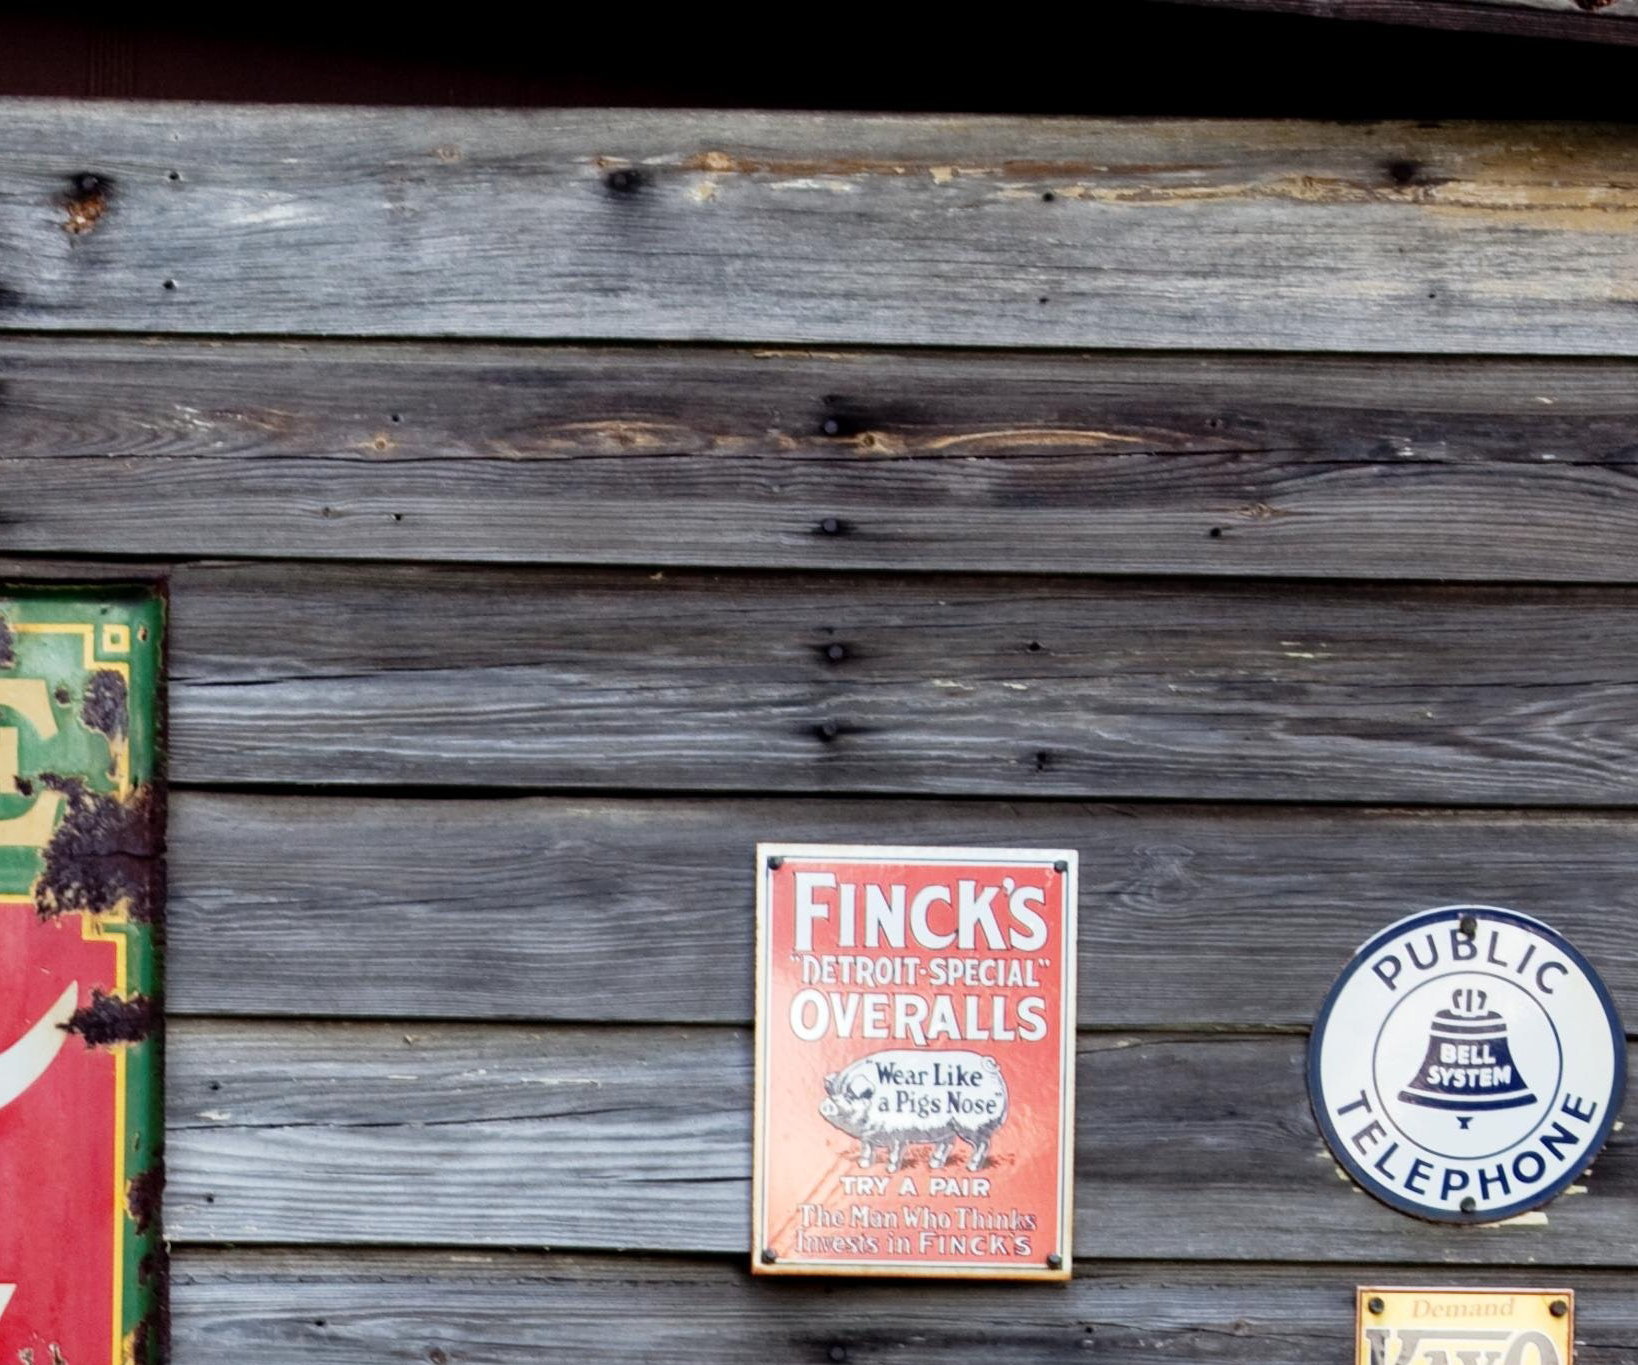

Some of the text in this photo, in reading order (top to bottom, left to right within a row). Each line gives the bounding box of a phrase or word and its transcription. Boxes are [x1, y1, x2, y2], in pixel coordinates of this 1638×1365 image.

[792, 870, 1048, 952] FINCK'S
[1372, 928, 1569, 994] PUBLIC
[788, 988, 1049, 1047] OVERALLS
[1439, 1042, 1497, 1066] BELL
[933, 1062, 983, 1088] Like
[1426, 1064, 1512, 1089] SYSTEM
[877, 1096, 890, 1114] a
[895, 1090, 941, 1118] Pigs
[1336, 1088, 1598, 1201] TELEPHONE
[839, 1175, 991, 1199] TRY A PAIR
[797, 1203, 1038, 1233] The Man Who Thinks
[794, 1231, 879, 1255] Invests
[886, 1232, 912, 1255] in
[1411, 1296, 1516, 1319] Demand
